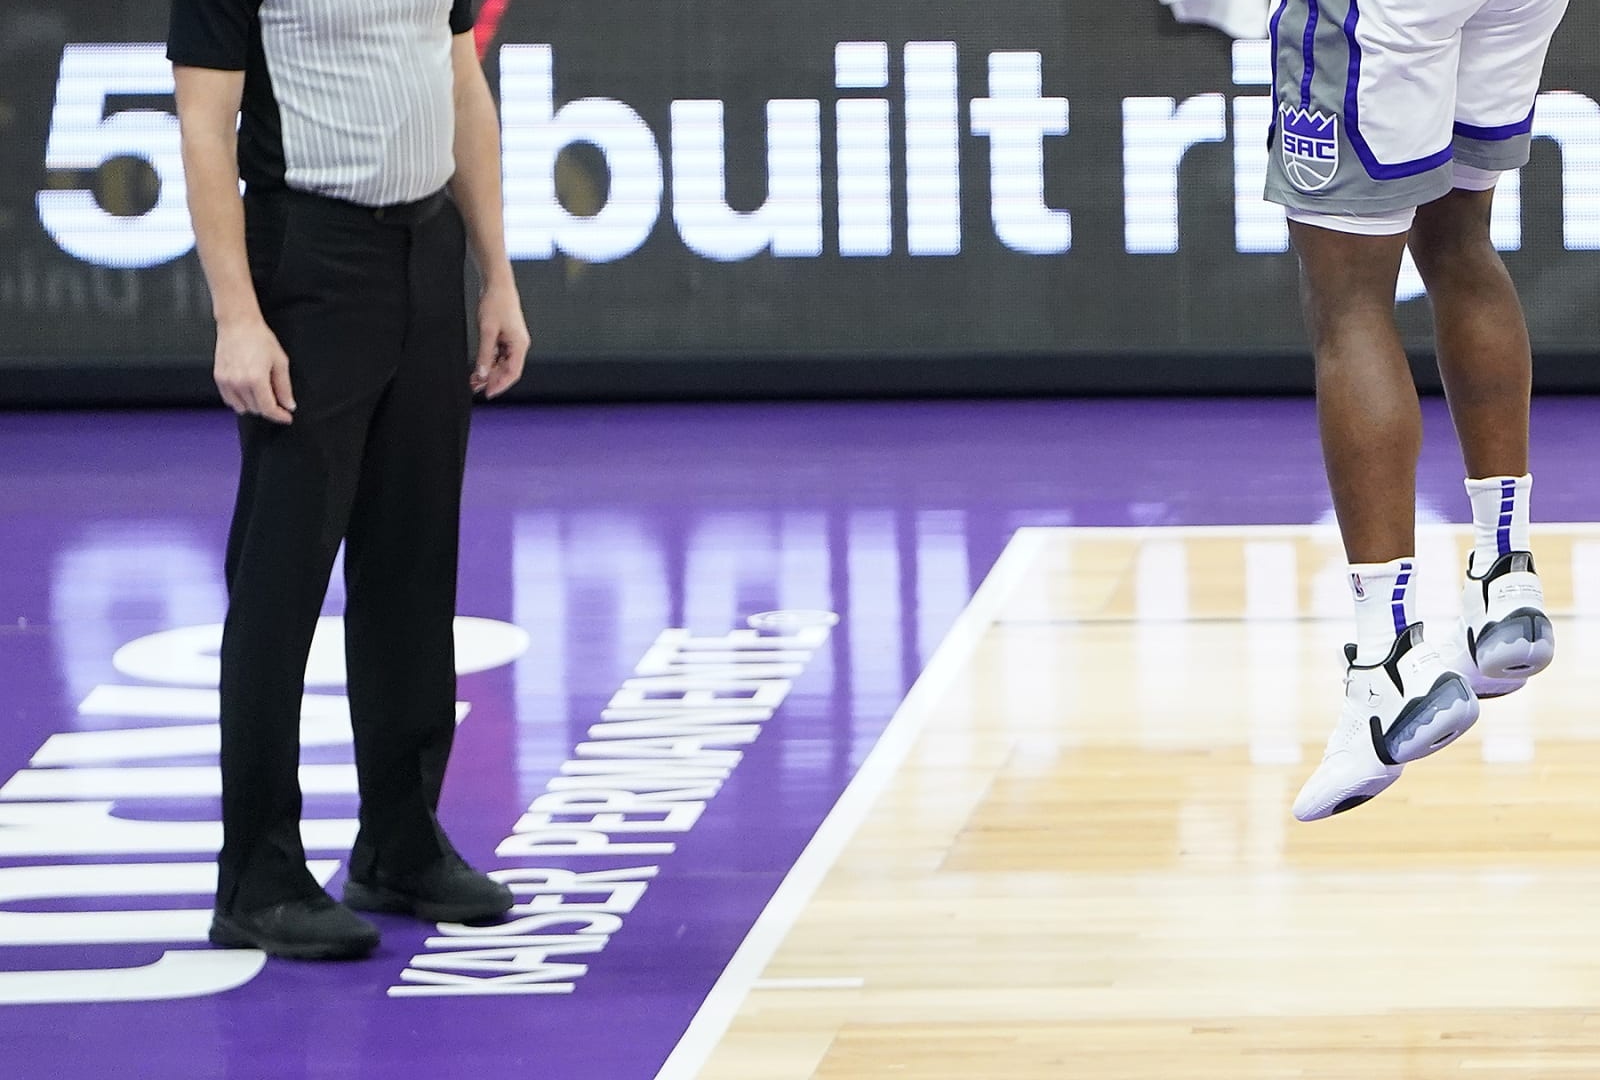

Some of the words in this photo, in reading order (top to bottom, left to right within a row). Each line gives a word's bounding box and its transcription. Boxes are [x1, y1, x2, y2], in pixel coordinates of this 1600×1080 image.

[500, 40, 1072, 263] built
[1283, 133, 1336, 160] SAC
[387, 866, 661, 998] KAISER
